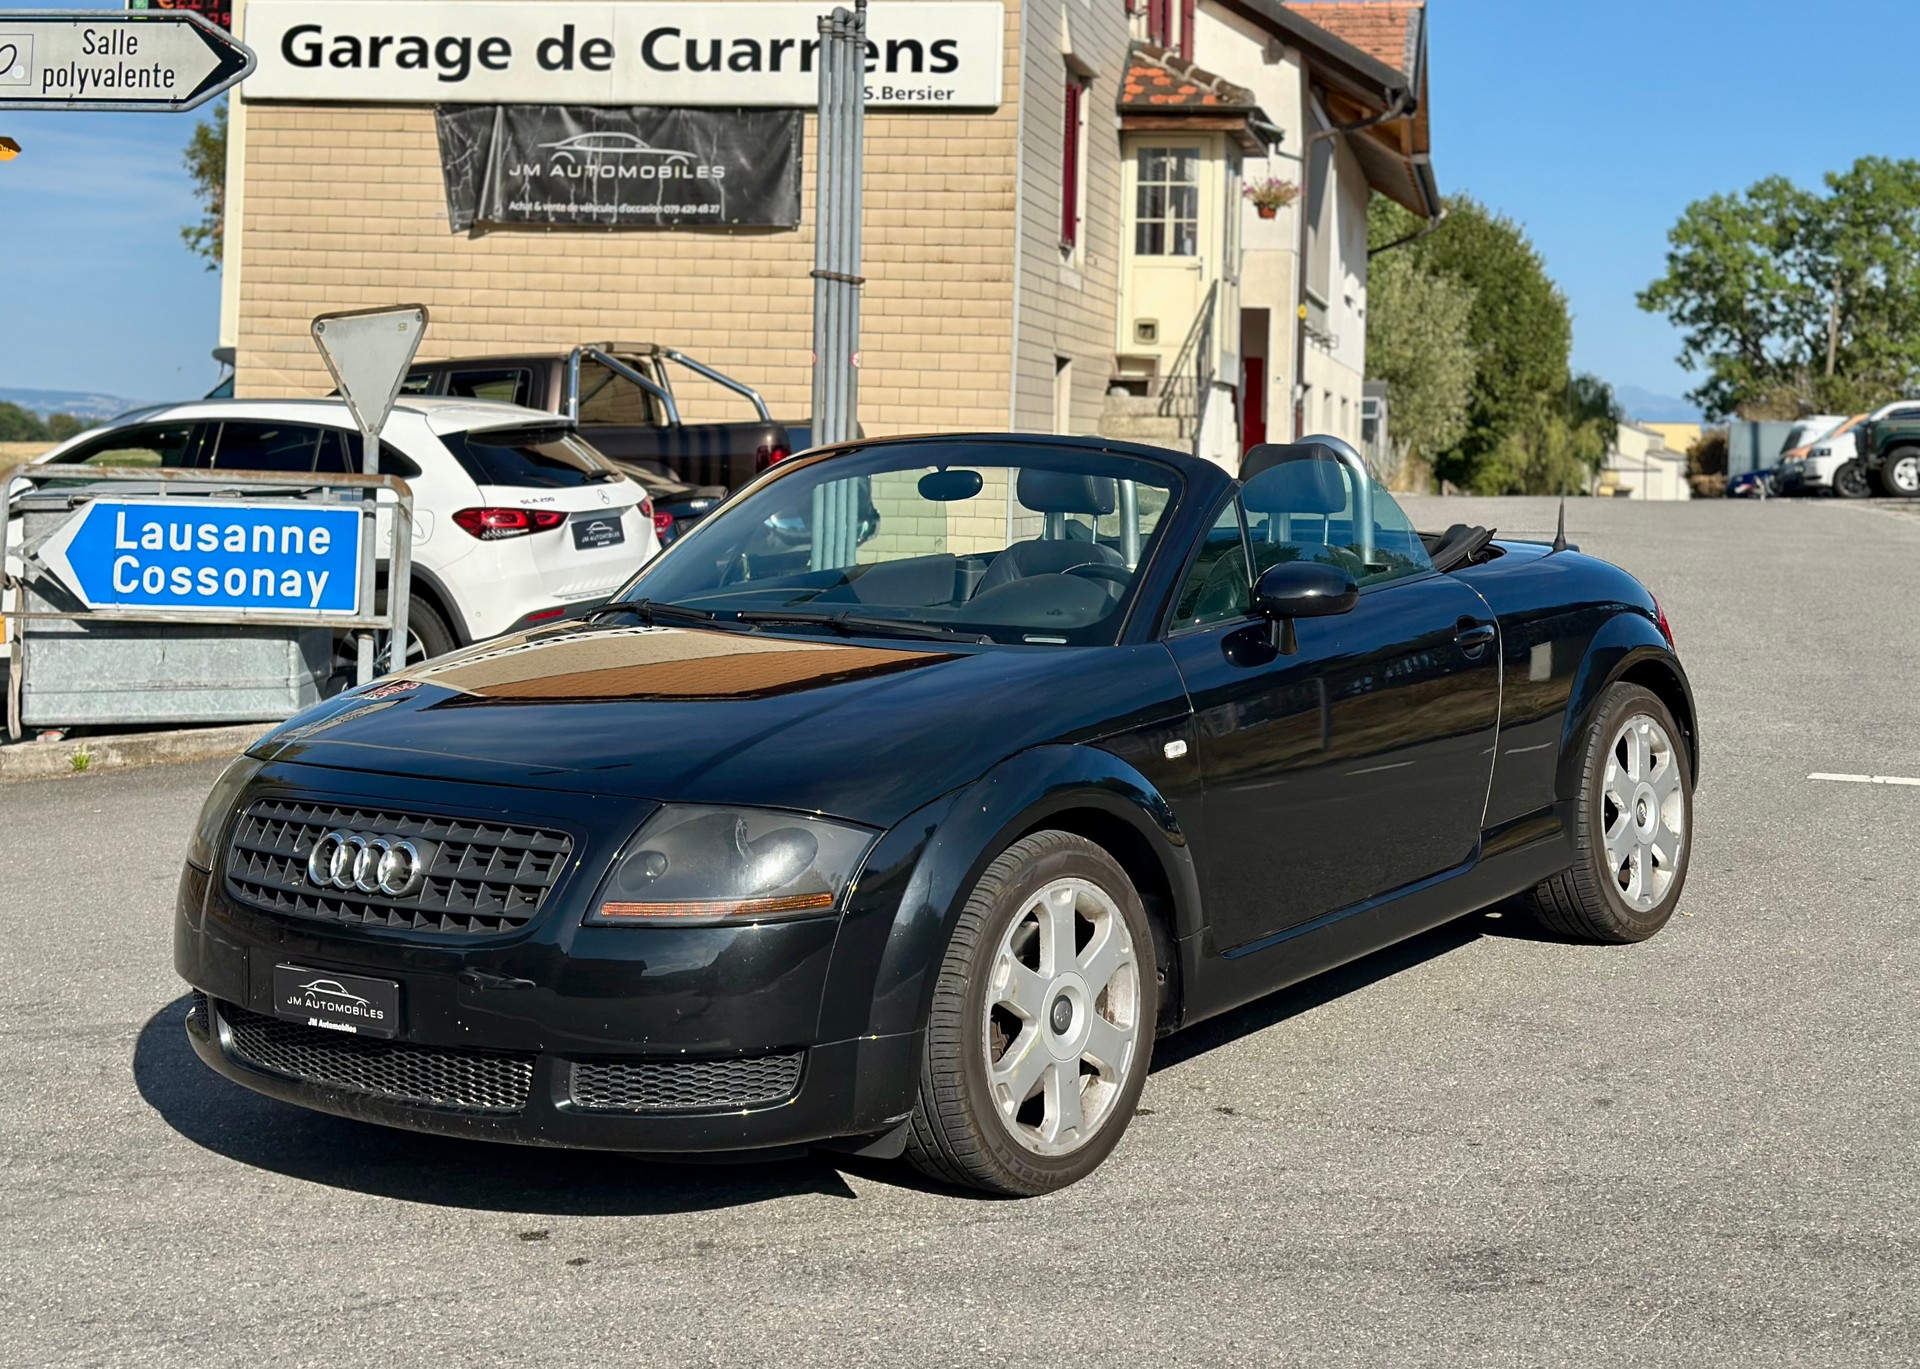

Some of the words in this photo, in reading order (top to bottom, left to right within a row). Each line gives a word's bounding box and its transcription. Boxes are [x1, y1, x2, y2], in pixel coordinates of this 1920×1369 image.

[82, 28, 138, 55] Salle
[281, 23, 512, 83] Garage
[536, 24, 616, 72] de
[42, 61, 175, 94] polyvalente
[508, 164, 541, 177] JM
[550, 164, 726, 179] AUTOMOBILES
[508, 201, 533, 212] Achat
[542, 202, 566, 213] vente
[567, 202, 578, 213] de
[580, 202, 618, 213] véhicules
[619, 202, 662, 214] d'occasion
[663, 204, 680, 214] 079
[115, 511, 331, 555] Lausanne
[113, 555, 330, 607] Cossonay
[287, 996, 302, 1006] JM
[305, 999, 384, 1019] AUTOMOBILES
[308, 1017, 318, 1027] JM
[318, 1019, 357, 1034] Automobiles
